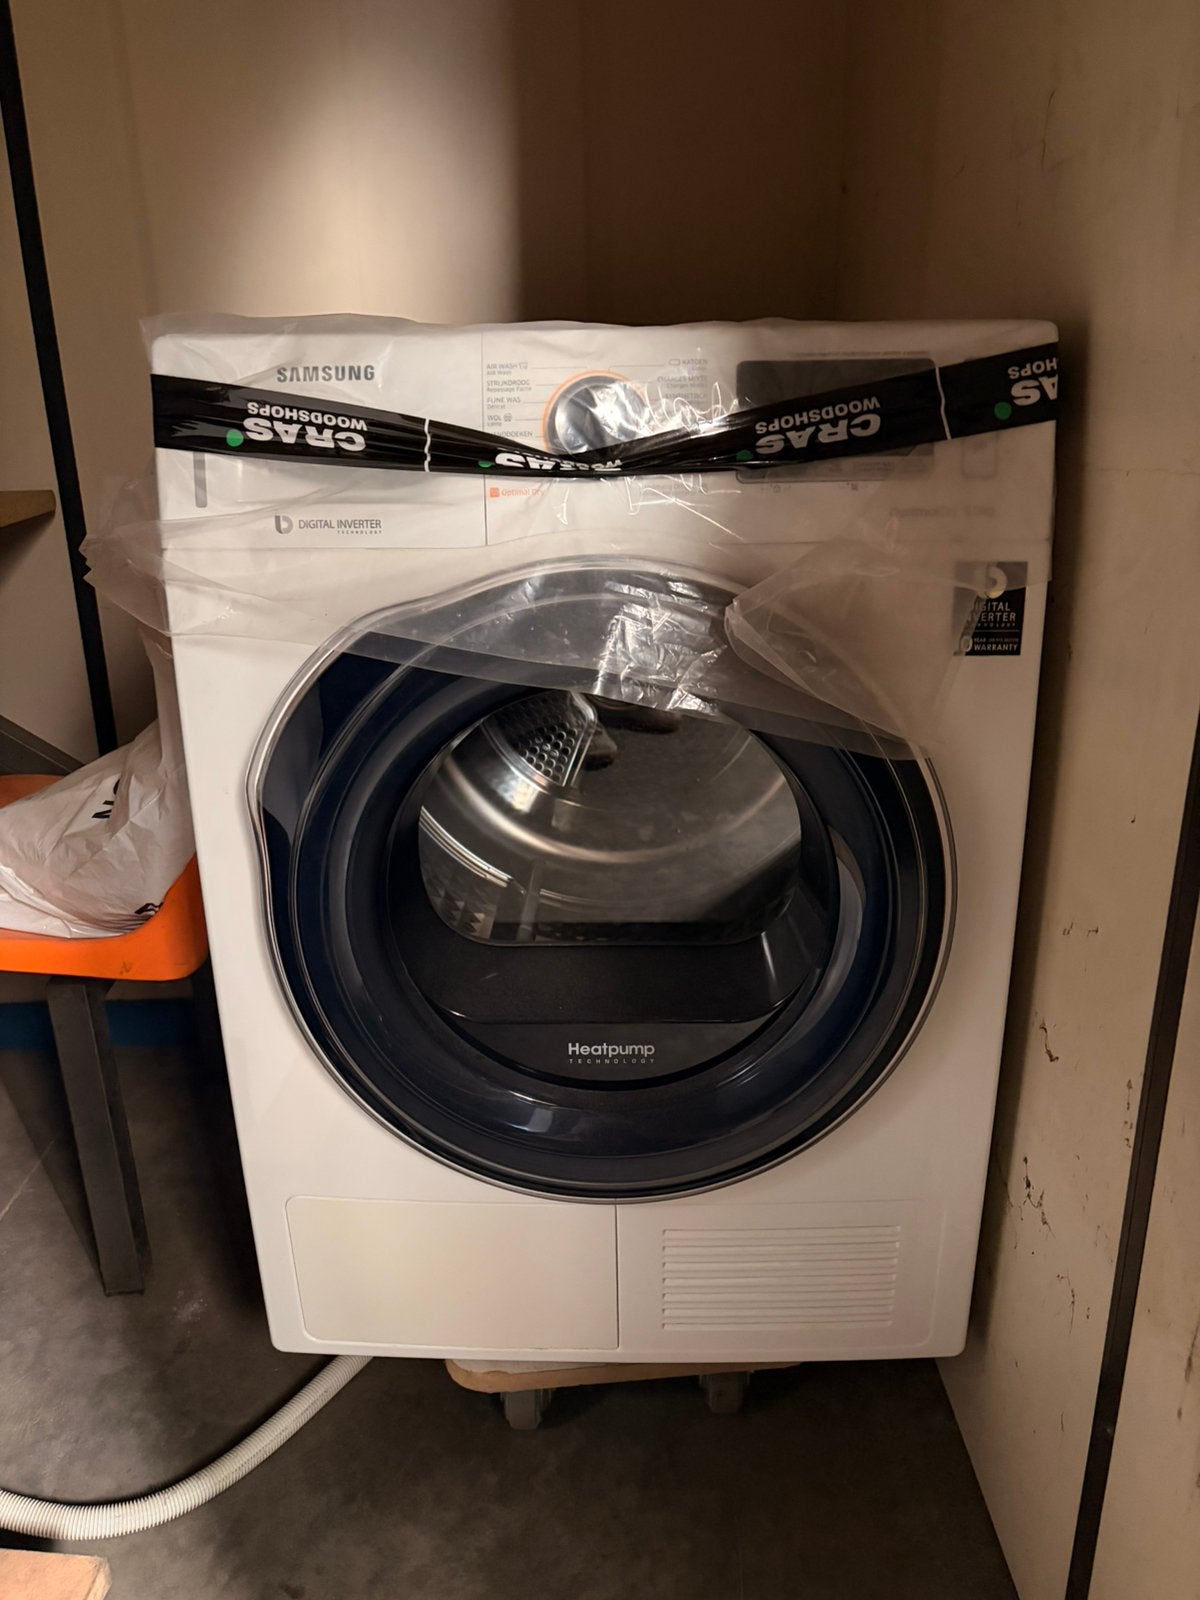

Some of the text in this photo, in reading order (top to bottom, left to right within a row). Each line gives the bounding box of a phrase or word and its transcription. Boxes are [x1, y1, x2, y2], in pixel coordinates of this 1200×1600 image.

[276, 365, 375, 383] SAMSUNG
[1007, 357, 1058, 379] HOPS
[1010, 374, 1058, 406] AS
[247, 401, 368, 431] WOODSHOPS
[755, 396, 880, 434] WOODSHOPS
[243, 417, 366, 451] CRAS
[755, 413, 880, 455] CRAS
[298, 519, 382, 529] DIGITAL INVERTER
[973, 643, 1018, 651] WARRANTY
[567, 1042, 656, 1058] Heatpump
